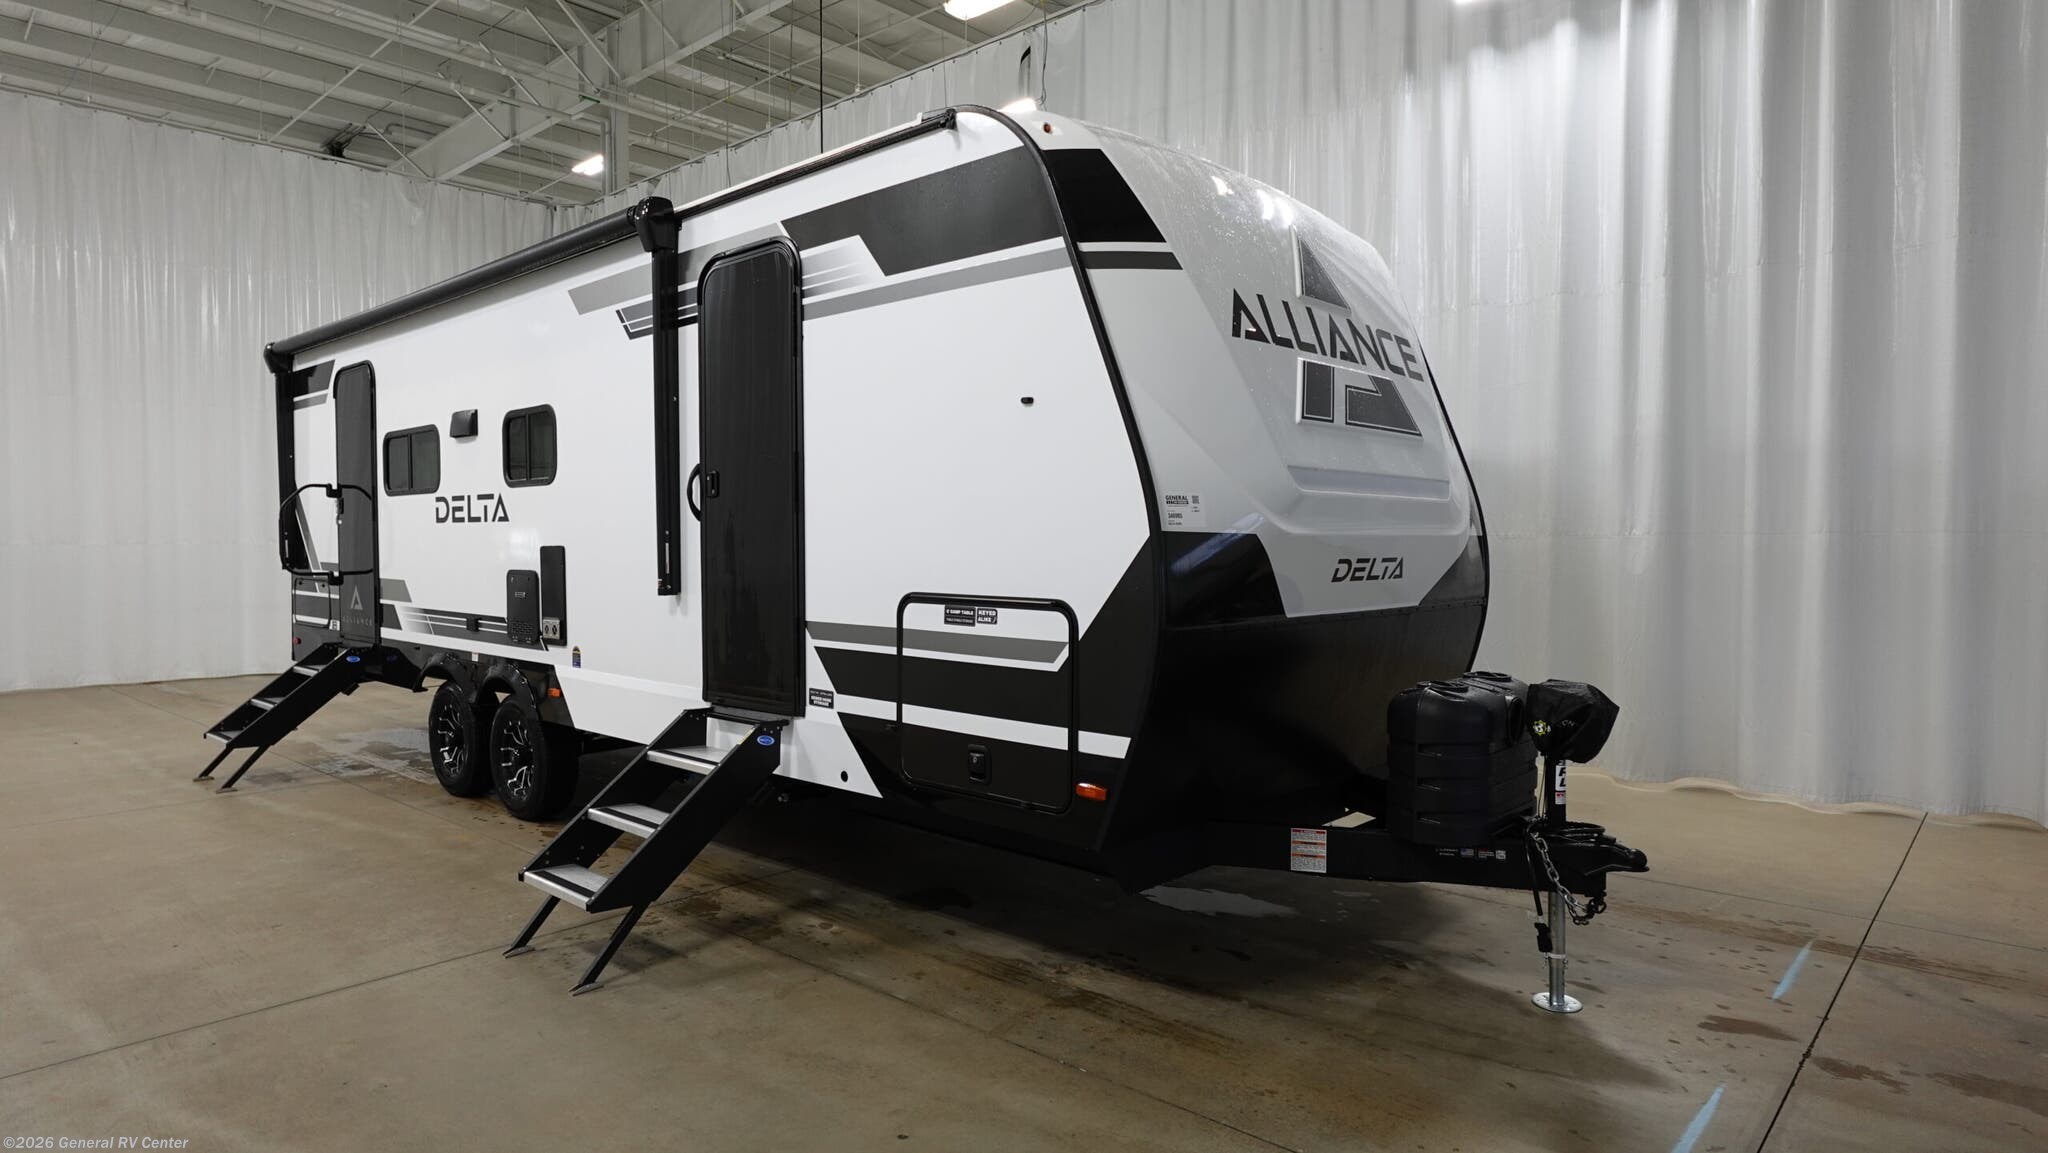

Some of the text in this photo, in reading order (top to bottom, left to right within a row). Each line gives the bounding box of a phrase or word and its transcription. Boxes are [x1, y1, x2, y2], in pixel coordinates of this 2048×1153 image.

[1232, 288, 1424, 382] ALLIANCE
[435, 493, 510, 524] DELTA
[1331, 556, 1404, 583] DELTA
